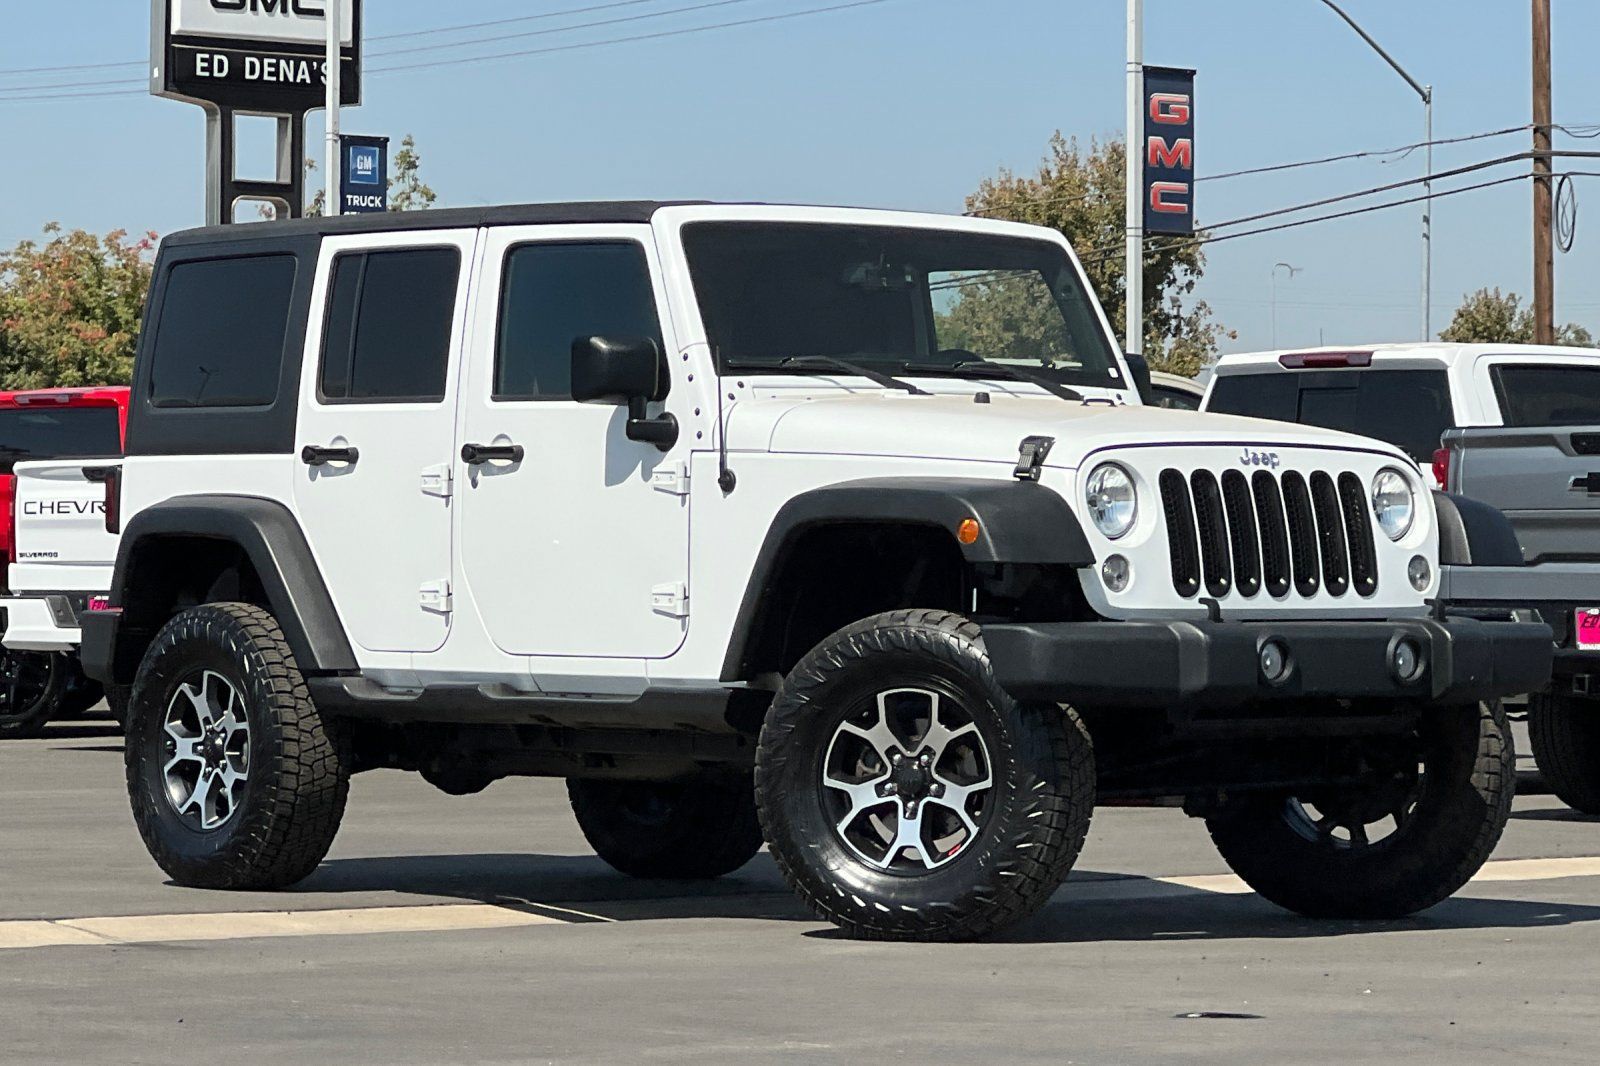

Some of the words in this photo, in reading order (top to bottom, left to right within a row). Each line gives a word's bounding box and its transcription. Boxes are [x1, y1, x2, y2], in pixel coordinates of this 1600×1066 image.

[196, 53, 229, 78] ED
[357, 155, 372, 170] GM
[1148, 92, 1192, 214] GMC
[346, 194, 382, 207] TRUCK
[1239, 447, 1280, 469] Jeep
